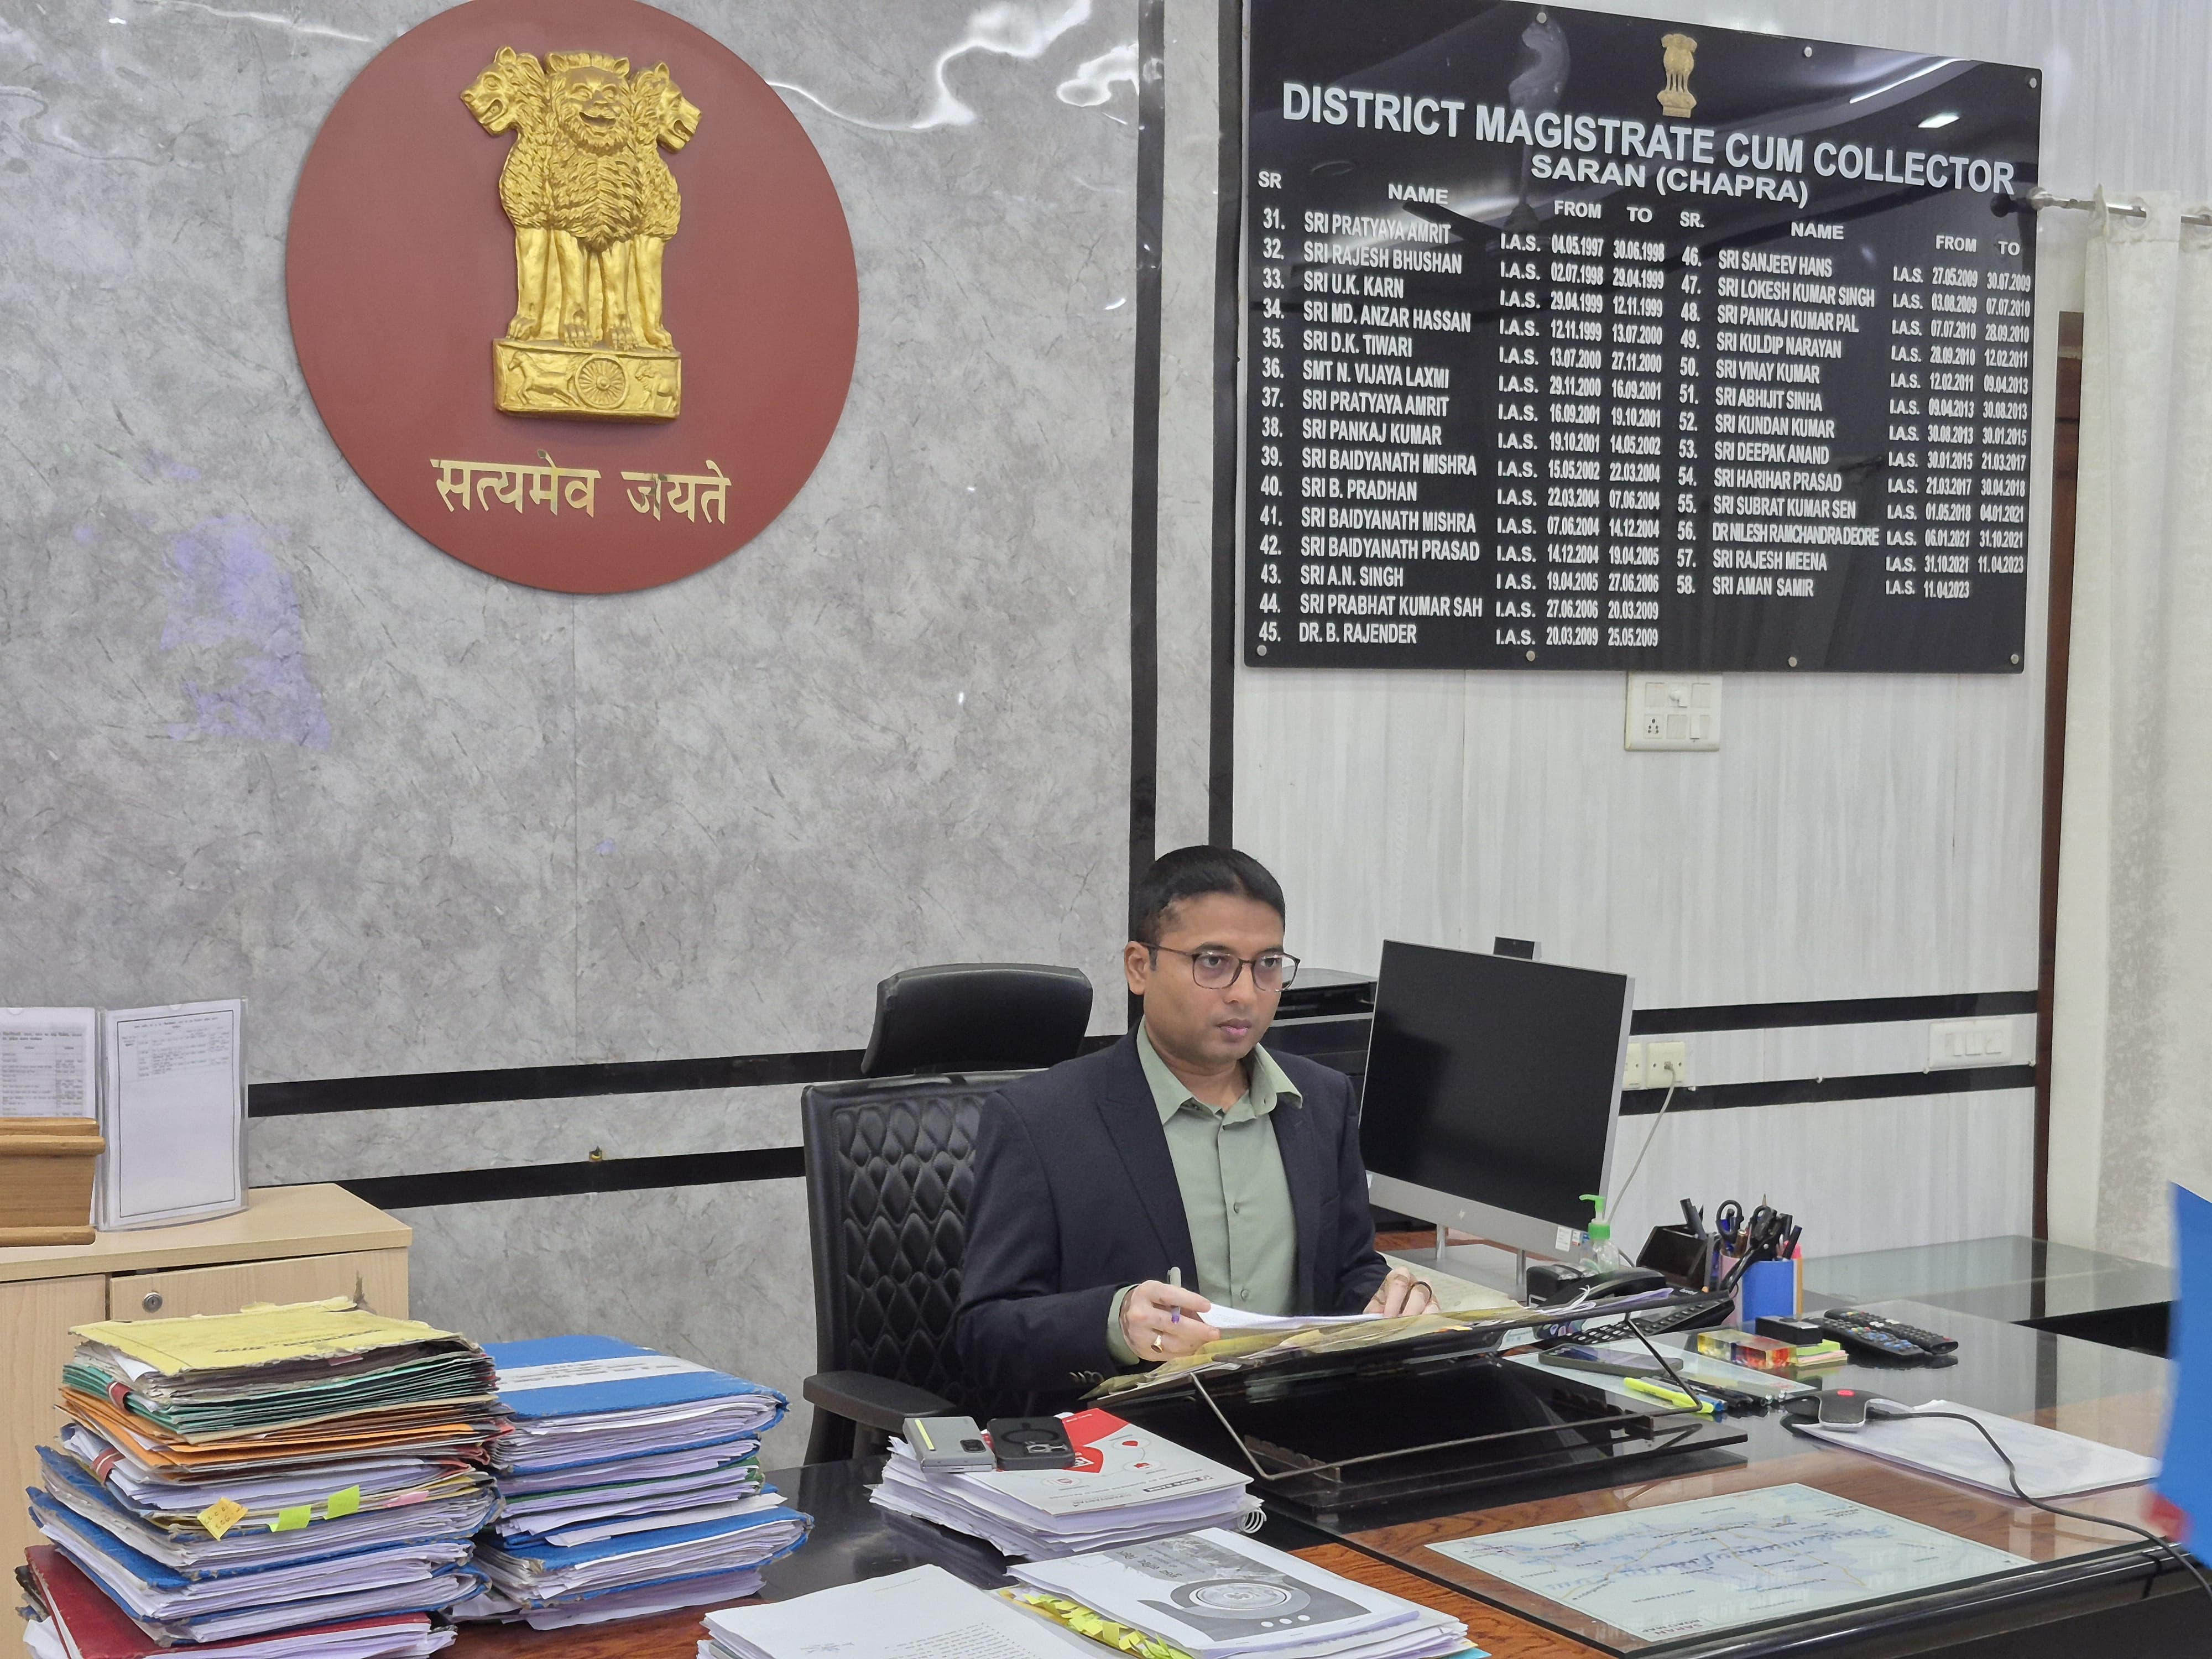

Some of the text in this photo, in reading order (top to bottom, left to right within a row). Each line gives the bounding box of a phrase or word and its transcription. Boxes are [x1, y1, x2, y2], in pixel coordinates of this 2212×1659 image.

[1283, 82, 2015, 195] DISTRICT MAGISTRATE CUM COLLECTOR
[1531, 154, 1808, 208] SARAN (CHAPRA)
[1258, 171, 2020, 255] SR NAME FROM TO SR. NAME FROM TO
[1262, 210, 1665, 262] 31. SRI PRATYAYA AMRIT I.A.S. 04.05.1997 30.06.1998
[1262, 239, 1462, 274] 32. SRI RAJESH BHUSHAN
[1681, 246, 2031, 292] 46. SRI SANJEEV HANS I.A.S. 27.05.2009 30.07.2009
[1262, 269, 1404, 299] 33. SRI U.K. KARN
[1681, 274, 1875, 307] 47. SRI LOKESH KUMAR SINGH
[1262, 299, 1471, 332] 34. SRI MD. ANZAR HASSAN
[1680, 302, 1859, 332] 48. SRI PANKAJ KUMAR PAL
[1262, 328, 1412, 357] 35. SRI D.K. TIWARI
[1680, 328, 1841, 358] 49. SRI KULDIP NARAYAN
[1262, 358, 1449, 388] 36. SMT N. VIJAYA LAXMI
[1679, 357, 1819, 384] 50. SRI VINAY KUMAR
[1261, 388, 1449, 416] 37. SRI PRATYAYA AMRIT
[1679, 383, 1822, 411] 51. SRI ABHIJIT SINHA
[1261, 417, 1442, 445] 38. SRI PANKAJ KUMAR
[1678, 411, 1834, 438] 52. SRI KUNDAN KUMAR
[1261, 447, 1477, 476] 39. SRI BAIDYANATH MISHRA
[1678, 439, 1829, 465] 53. SRI DEEPAK ANAND
[430, 449, 733, 524] सत्यमेव जयते
[1260, 476, 1417, 501] 40. SRI B. PRADHAN
[1677, 466, 1841, 492] 54. SRI HARIHAR PRASAD
[1260, 506, 1476, 533] 41. SRI BAIDYANATH MISHRA
[1677, 494, 1856, 519] 55. SRI SUBRAT KUMAR SEN
[1677, 520, 1696, 540] 56.
[1259, 535, 1480, 561] 42. SRI BAIDYANATH PRASAD
[1677, 549, 1827, 571] 57. SRI RAJESH MEENA
[1260, 565, 1404, 587] 43. SRI A.N. SINGH
[1676, 575, 1814, 597] 58. SRI AMAN SAMIR
[1259, 594, 1482, 617] 44. SRI PRABHAT KUMAR SAH
[1259, 624, 1658, 647] 45. DR. B. RAJENDER I.A.S. 20.03.2009 25.05.2009
